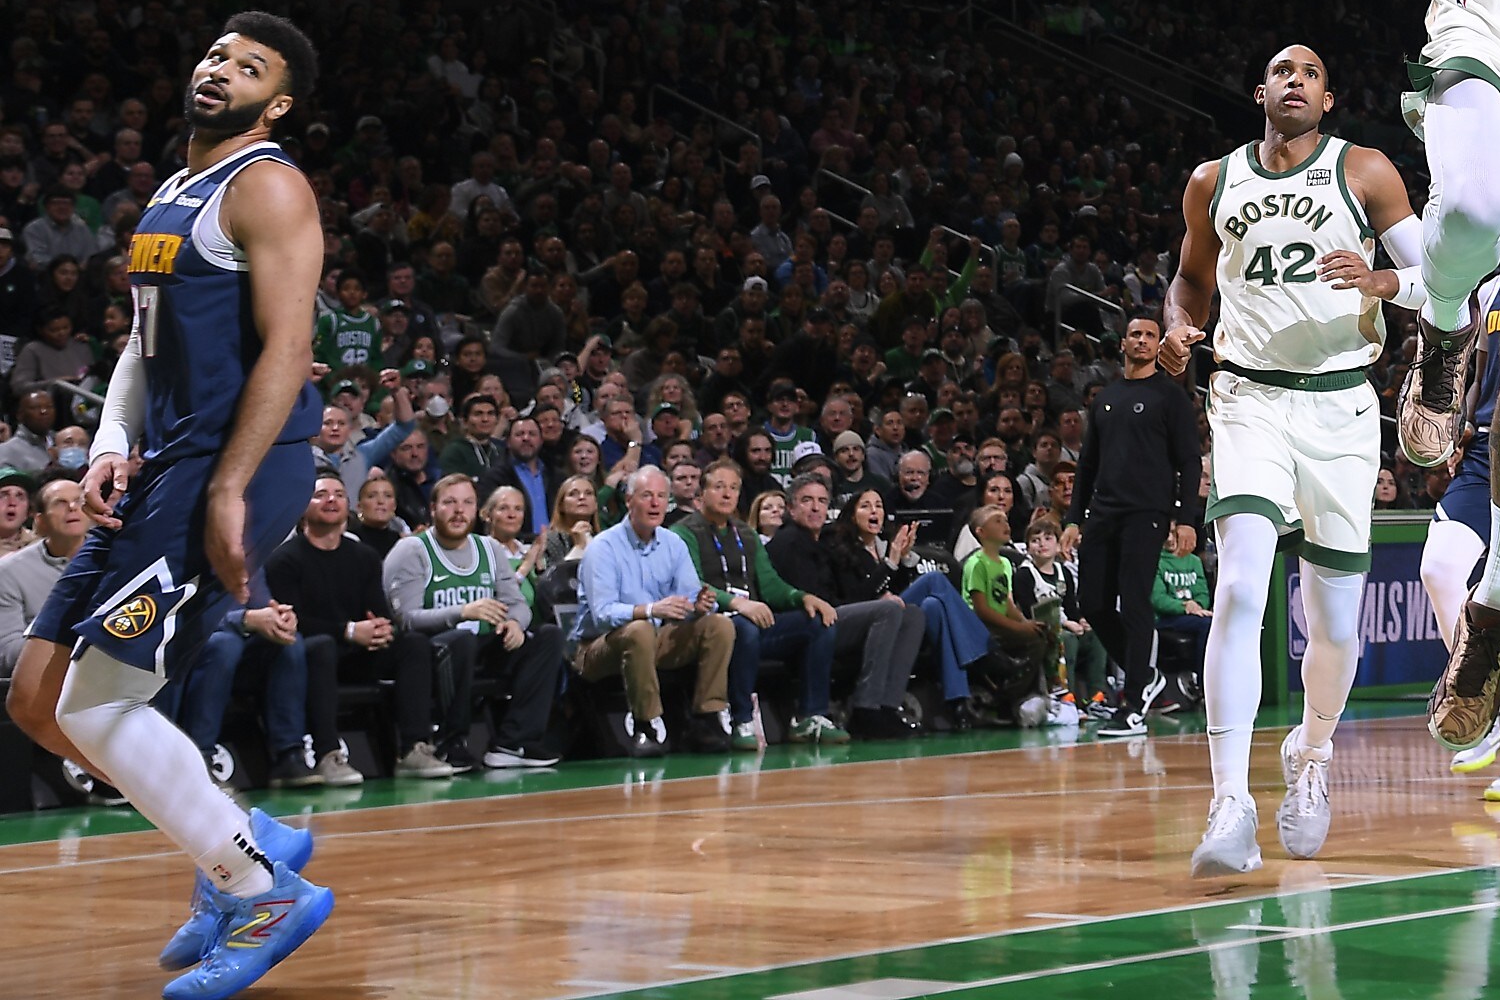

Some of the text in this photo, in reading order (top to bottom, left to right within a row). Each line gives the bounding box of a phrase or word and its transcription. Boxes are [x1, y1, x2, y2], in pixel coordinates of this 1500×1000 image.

[1307, 178, 1330, 186] PRINT
[1308, 170, 1331, 180] VISTA
[1224, 193, 1333, 242] BOSTON
[127, 233, 184, 275] ENVER
[1245, 242, 1317, 287] 42
[131, 284, 160, 358] 7
